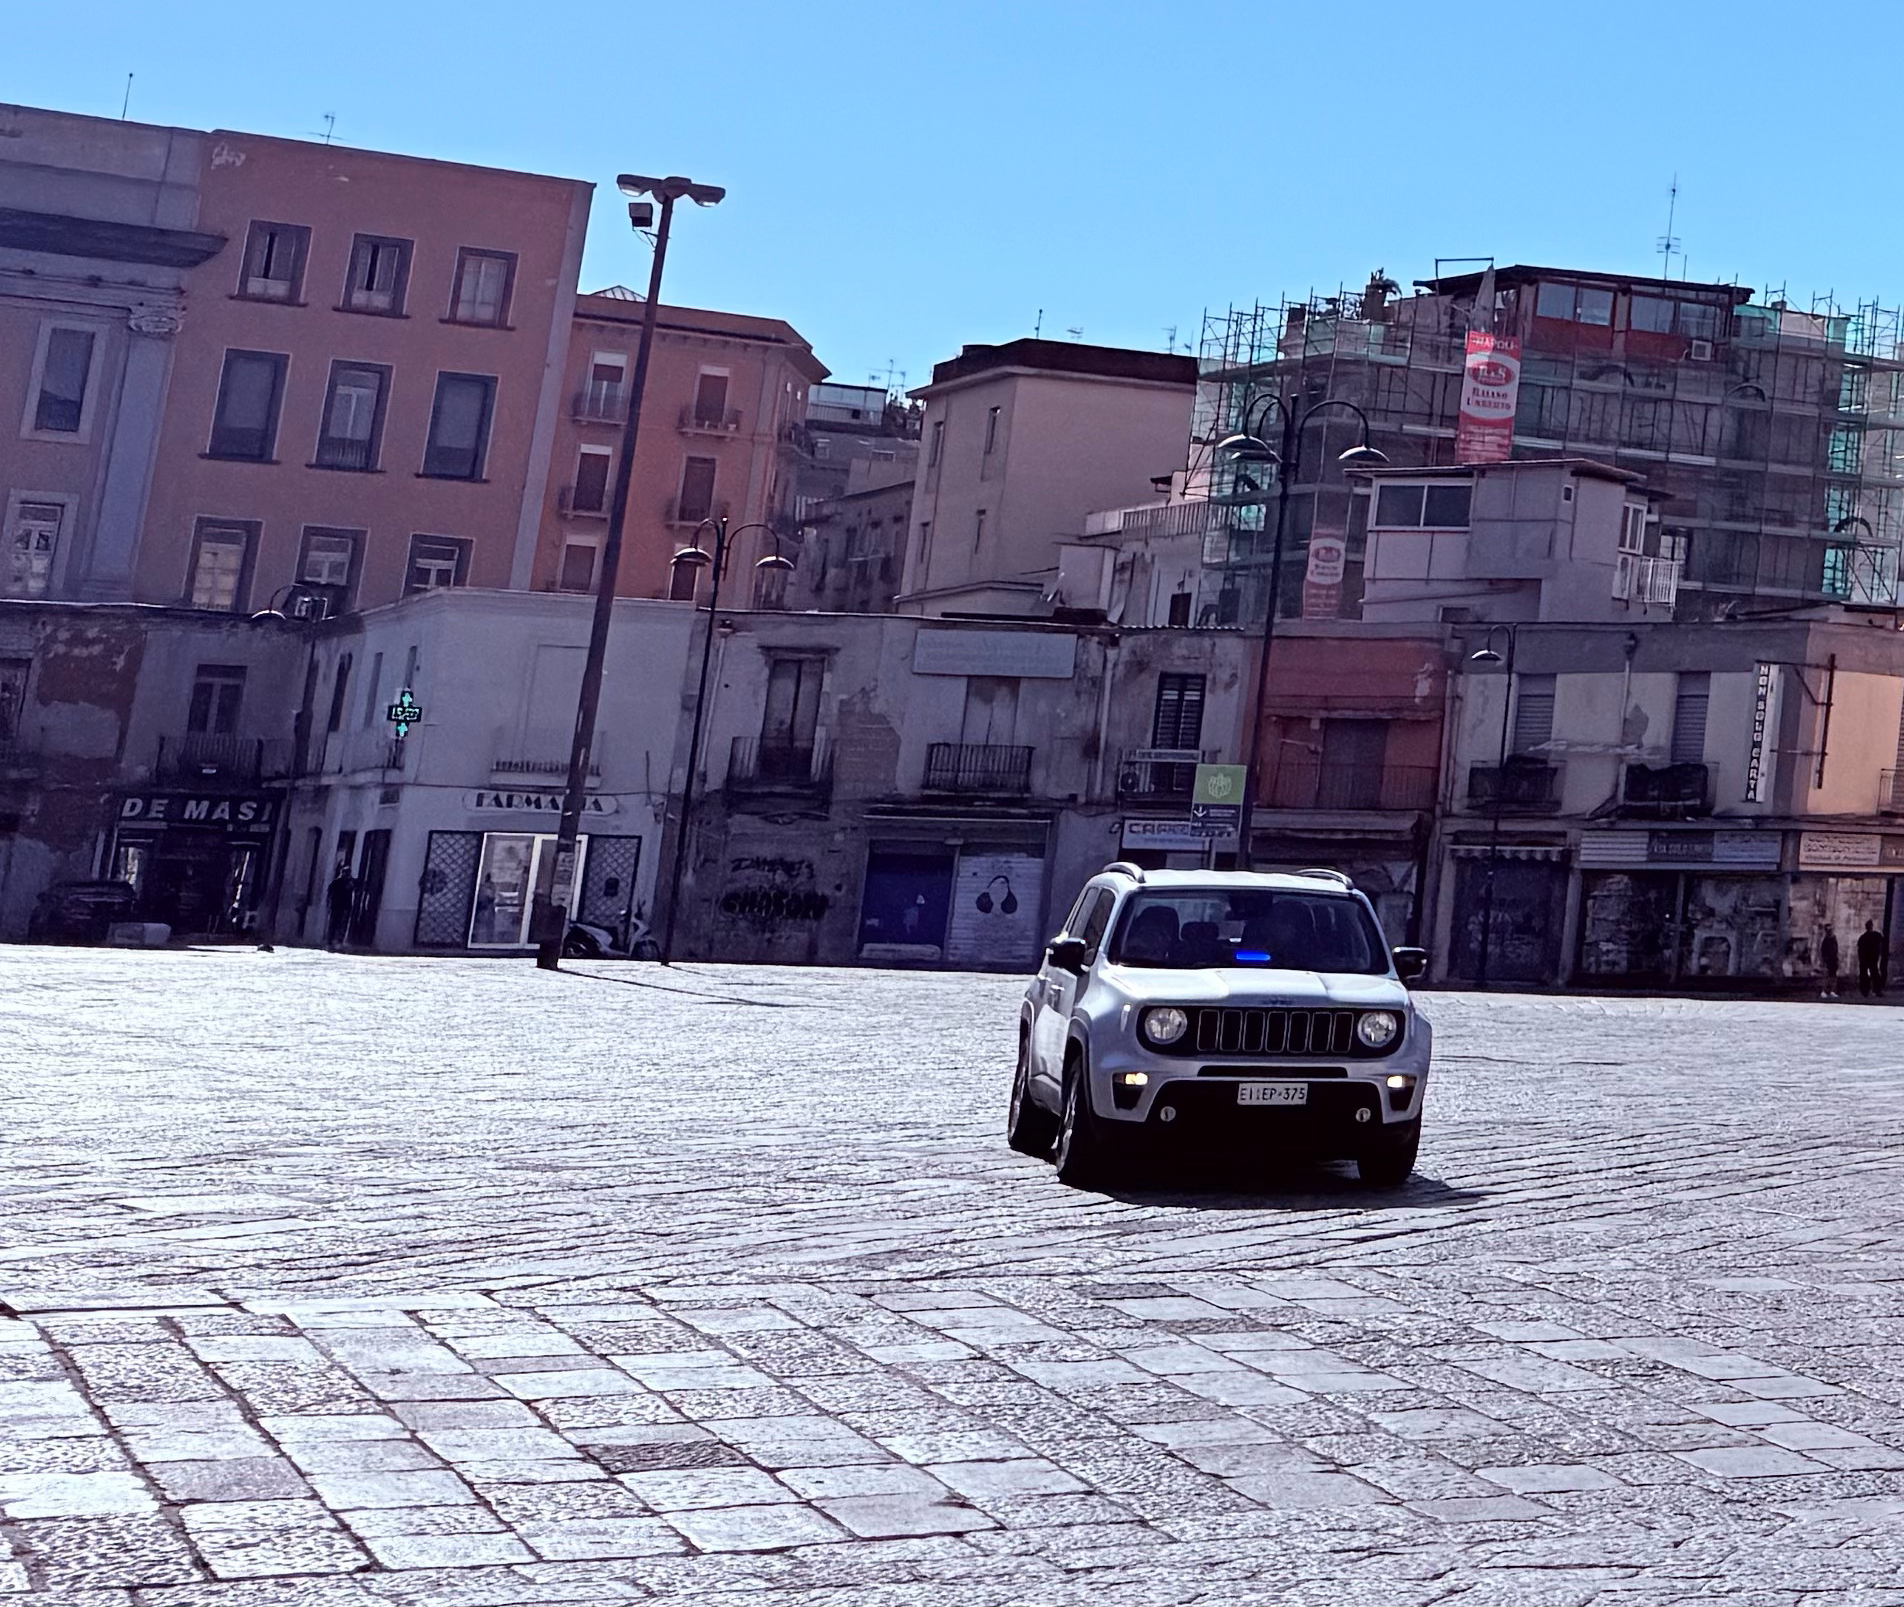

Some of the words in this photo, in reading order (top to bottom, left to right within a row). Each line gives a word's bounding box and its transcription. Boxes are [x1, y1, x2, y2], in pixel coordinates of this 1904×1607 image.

[1757, 665, 1769, 696] NON
[1753, 700, 1765, 742] SOLO
[1747, 747, 1761, 800] CARTA
[121, 797, 169, 818] DE
[183, 799, 273, 821] MASI
